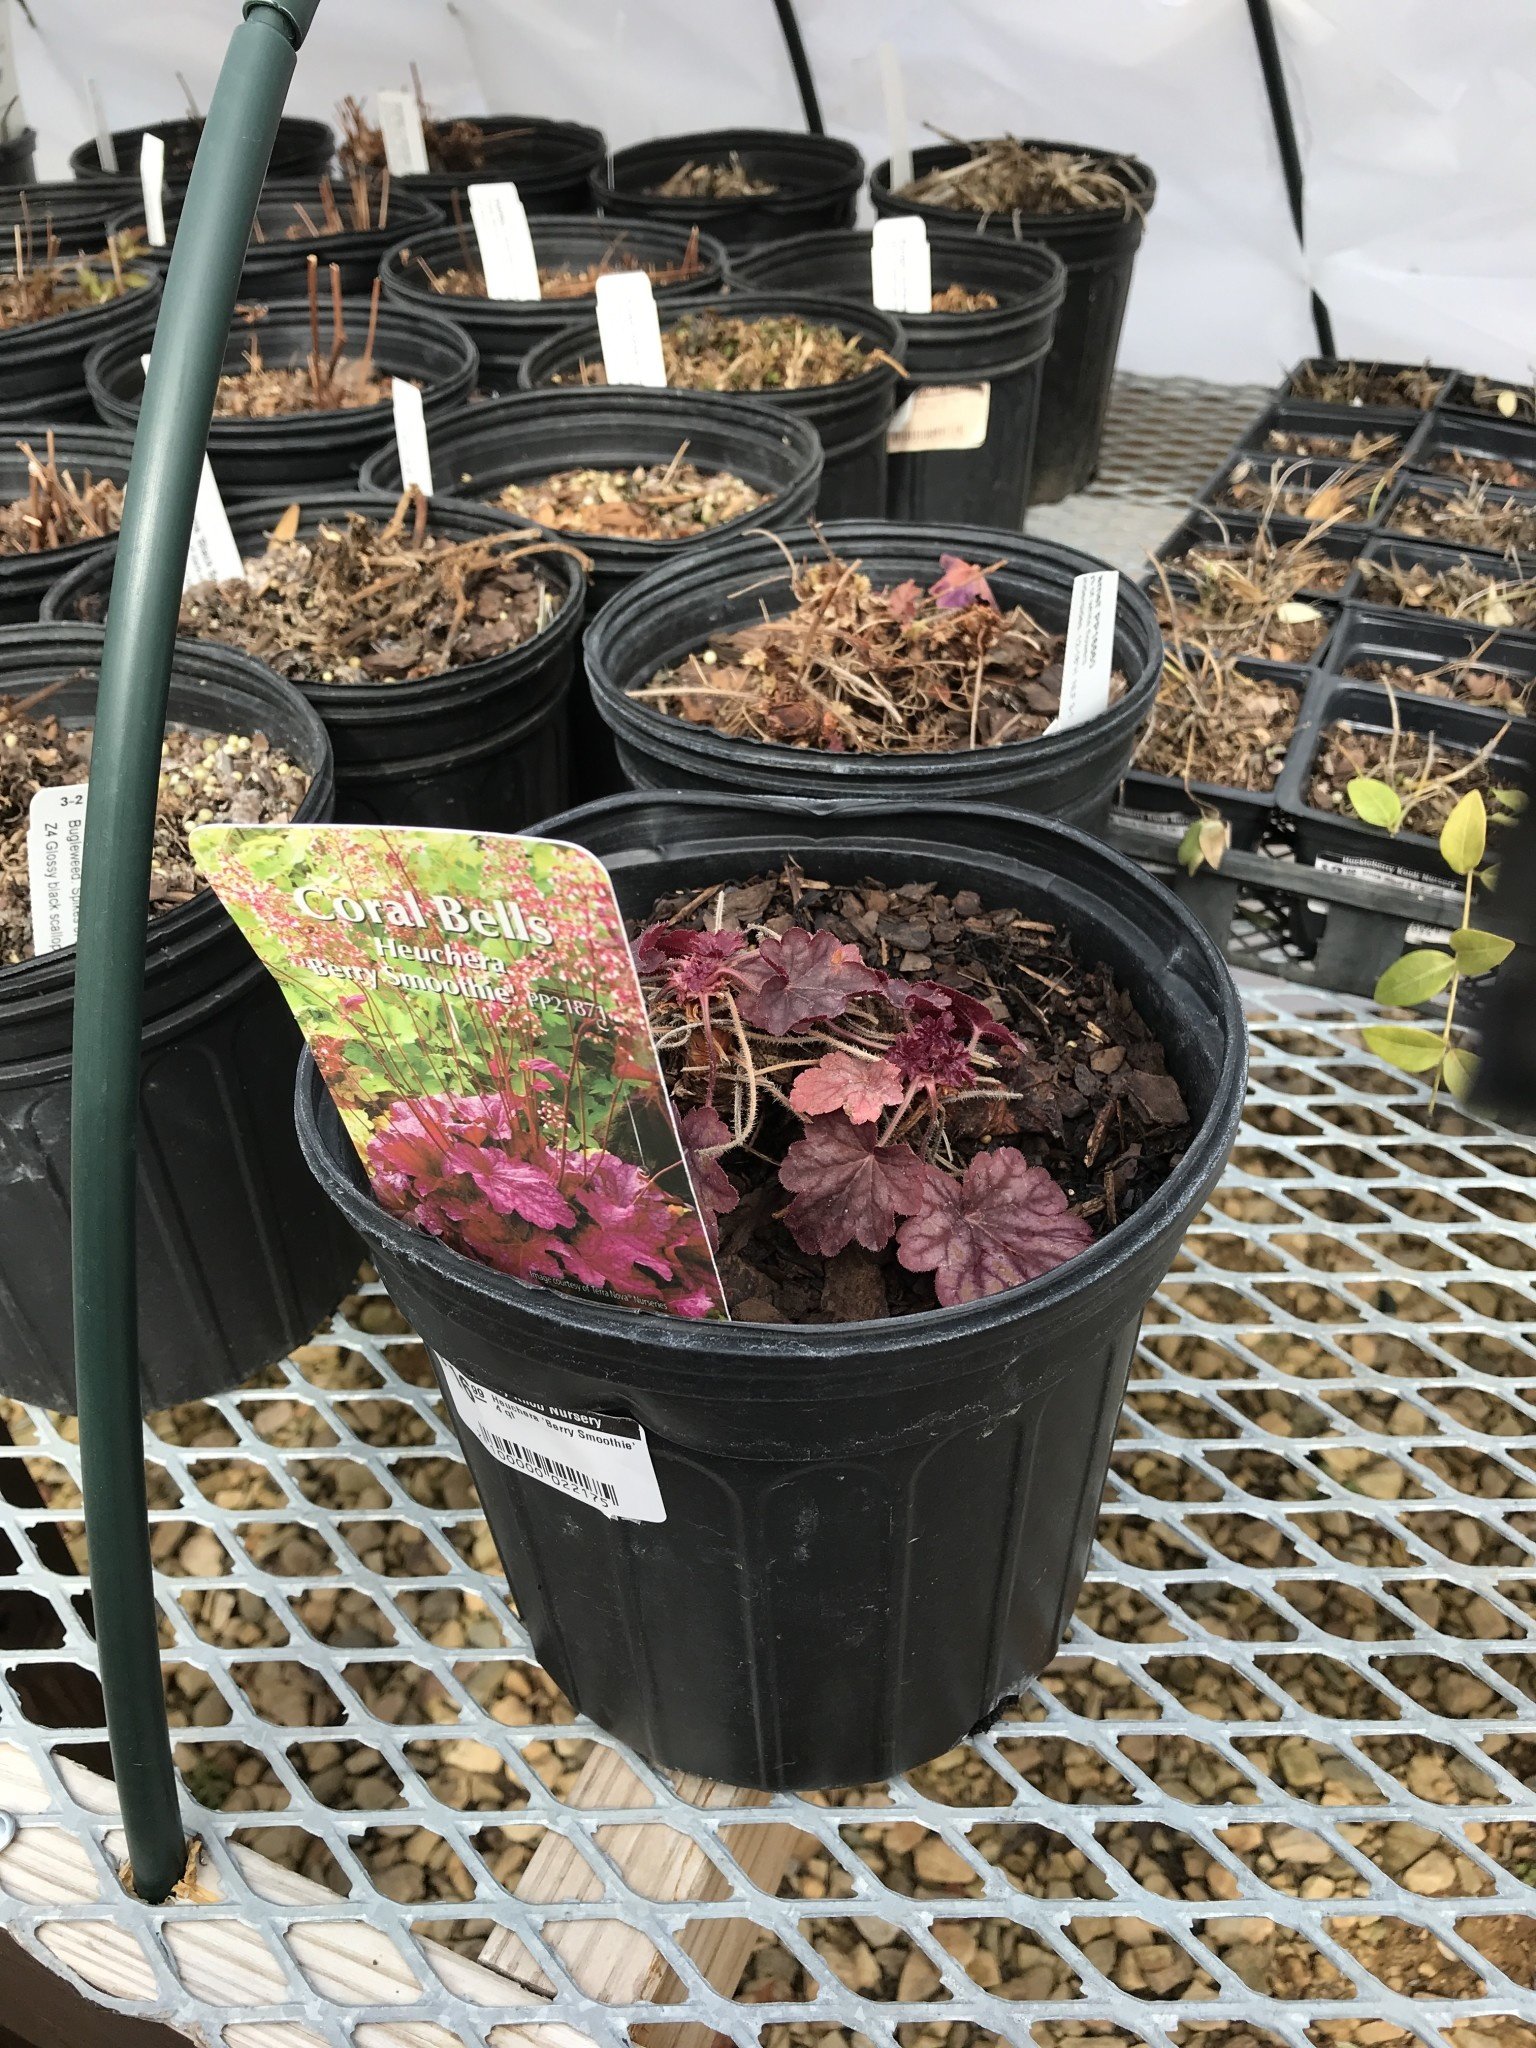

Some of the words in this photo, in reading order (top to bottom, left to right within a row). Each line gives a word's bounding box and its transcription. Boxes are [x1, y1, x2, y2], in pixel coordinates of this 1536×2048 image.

[44, 822, 58, 837] Z4
[44, 840, 59, 878] Glossy
[47, 881, 62, 911] black
[292, 885, 429, 928] Coral
[431, 894, 555, 946] Bells
[374, 936, 508, 975] Heuchera
[529, 1270, 552, 1284] Image
[552, 1276, 581, 1292] courtesy
[582, 1284, 590, 1292] of
[591, 1286, 610, 1297] Terra
[633, 1295, 668, 1310] Nurseries
[491, 1394, 540, 1422] Heuchera
[577, 1429, 636, 1450] Smoothie'
[549, 1406, 602, 1428] Nursery
